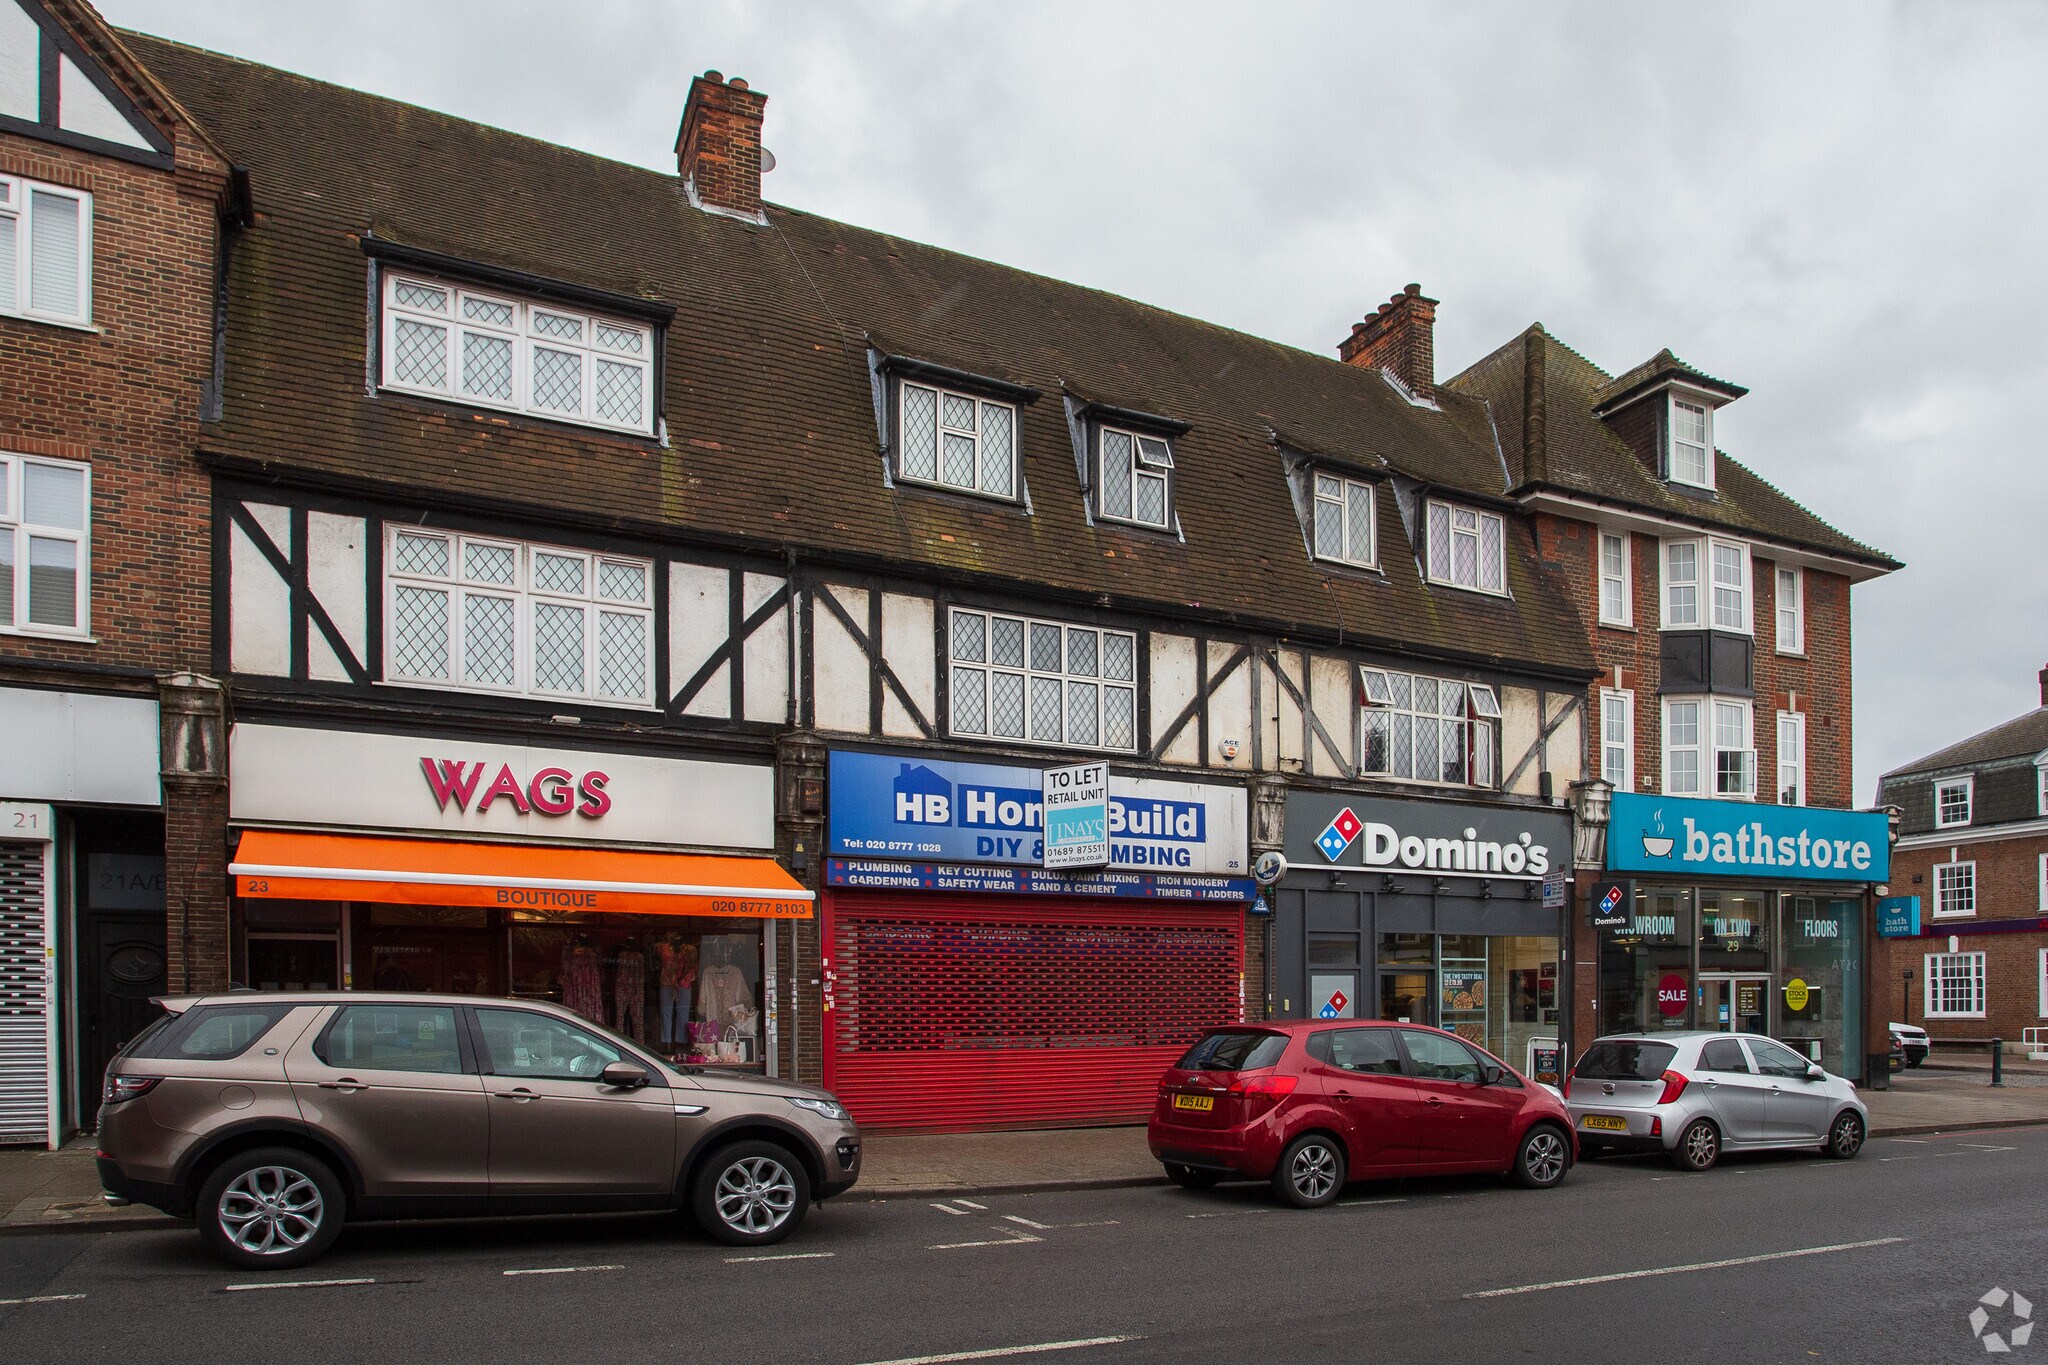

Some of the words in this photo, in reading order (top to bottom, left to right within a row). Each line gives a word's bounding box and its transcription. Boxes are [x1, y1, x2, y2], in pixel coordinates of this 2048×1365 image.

[1049, 772, 1071, 789] TO
[1074, 767, 1102, 786] LET
[419, 756, 612, 817] WAGS
[1047, 791, 1079, 804] RETAIL
[1081, 788, 1104, 801] UNIT
[896, 792, 950, 823] HB
[13, 812, 38, 829] 21
[1109, 801, 1197, 838] Build
[1047, 819, 1104, 845] LINAYS
[843, 838, 864, 849] Tel:
[866, 840, 886, 850] 020
[888, 842, 914, 851] 8777
[916, 843, 941, 853] 1028
[1362, 822, 1549, 876] Domino's
[1682, 817, 1871, 870] bathstore
[977, 836, 1023, 858] DIY
[1031, 840, 1044, 860] &
[1110, 844, 1191, 867] MBING
[1047, 847, 1074, 857] 01689
[1076, 844, 1105, 855] 875511
[1048, 854, 1104, 865] www.linays.co.uk
[1228, 860, 1239, 869] 25
[848, 862, 912, 874] PLUMBING
[938, 866, 960, 876] KEY
[963, 867, 1013, 879] CUTTING
[848, 875, 920, 887] GARDENING
[1031, 870, 1067, 881] DULUX
[1070, 872, 1101, 882] PAINT
[1103, 873, 1140, 884] MIXING
[1156, 876, 1181, 886] IRON
[1183, 877, 1229, 888] MONGERY
[248, 880, 269, 893] 23
[938, 878, 980, 889] SAFETY
[983, 880, 1015, 891] WEAR
[1031, 882, 1061, 892] SAND
[1063, 883, 1072, 893] &
[1074, 883, 1117, 894] CEMENT
[496, 889, 598, 908] BOUTIQUE
[1156, 888, 1192, 898] TIMBER
[1202, 890, 1244, 900] LADDERS
[711, 900, 737, 912] 020
[739, 901, 771, 914] 8777
[775, 902, 807, 915] 8103
[1594, 916, 1626, 926] Domino's
[1614, 916, 1675, 935] WROOM
[1713, 918, 1727, 937] ON
[1729, 918, 1751, 937] TWO
[1804, 919, 1838, 938] FLOORS
[1885, 917, 1907, 925] bath
[1884, 924, 1909, 933] store
[1726, 940, 1739, 952] 29
[1658, 989, 1687, 1002] SALE
[1194, 1098, 1210, 1110] AAJ
[1586, 1118, 1607, 1127] LX65
[1607, 1119, 1625, 1128] NNY
